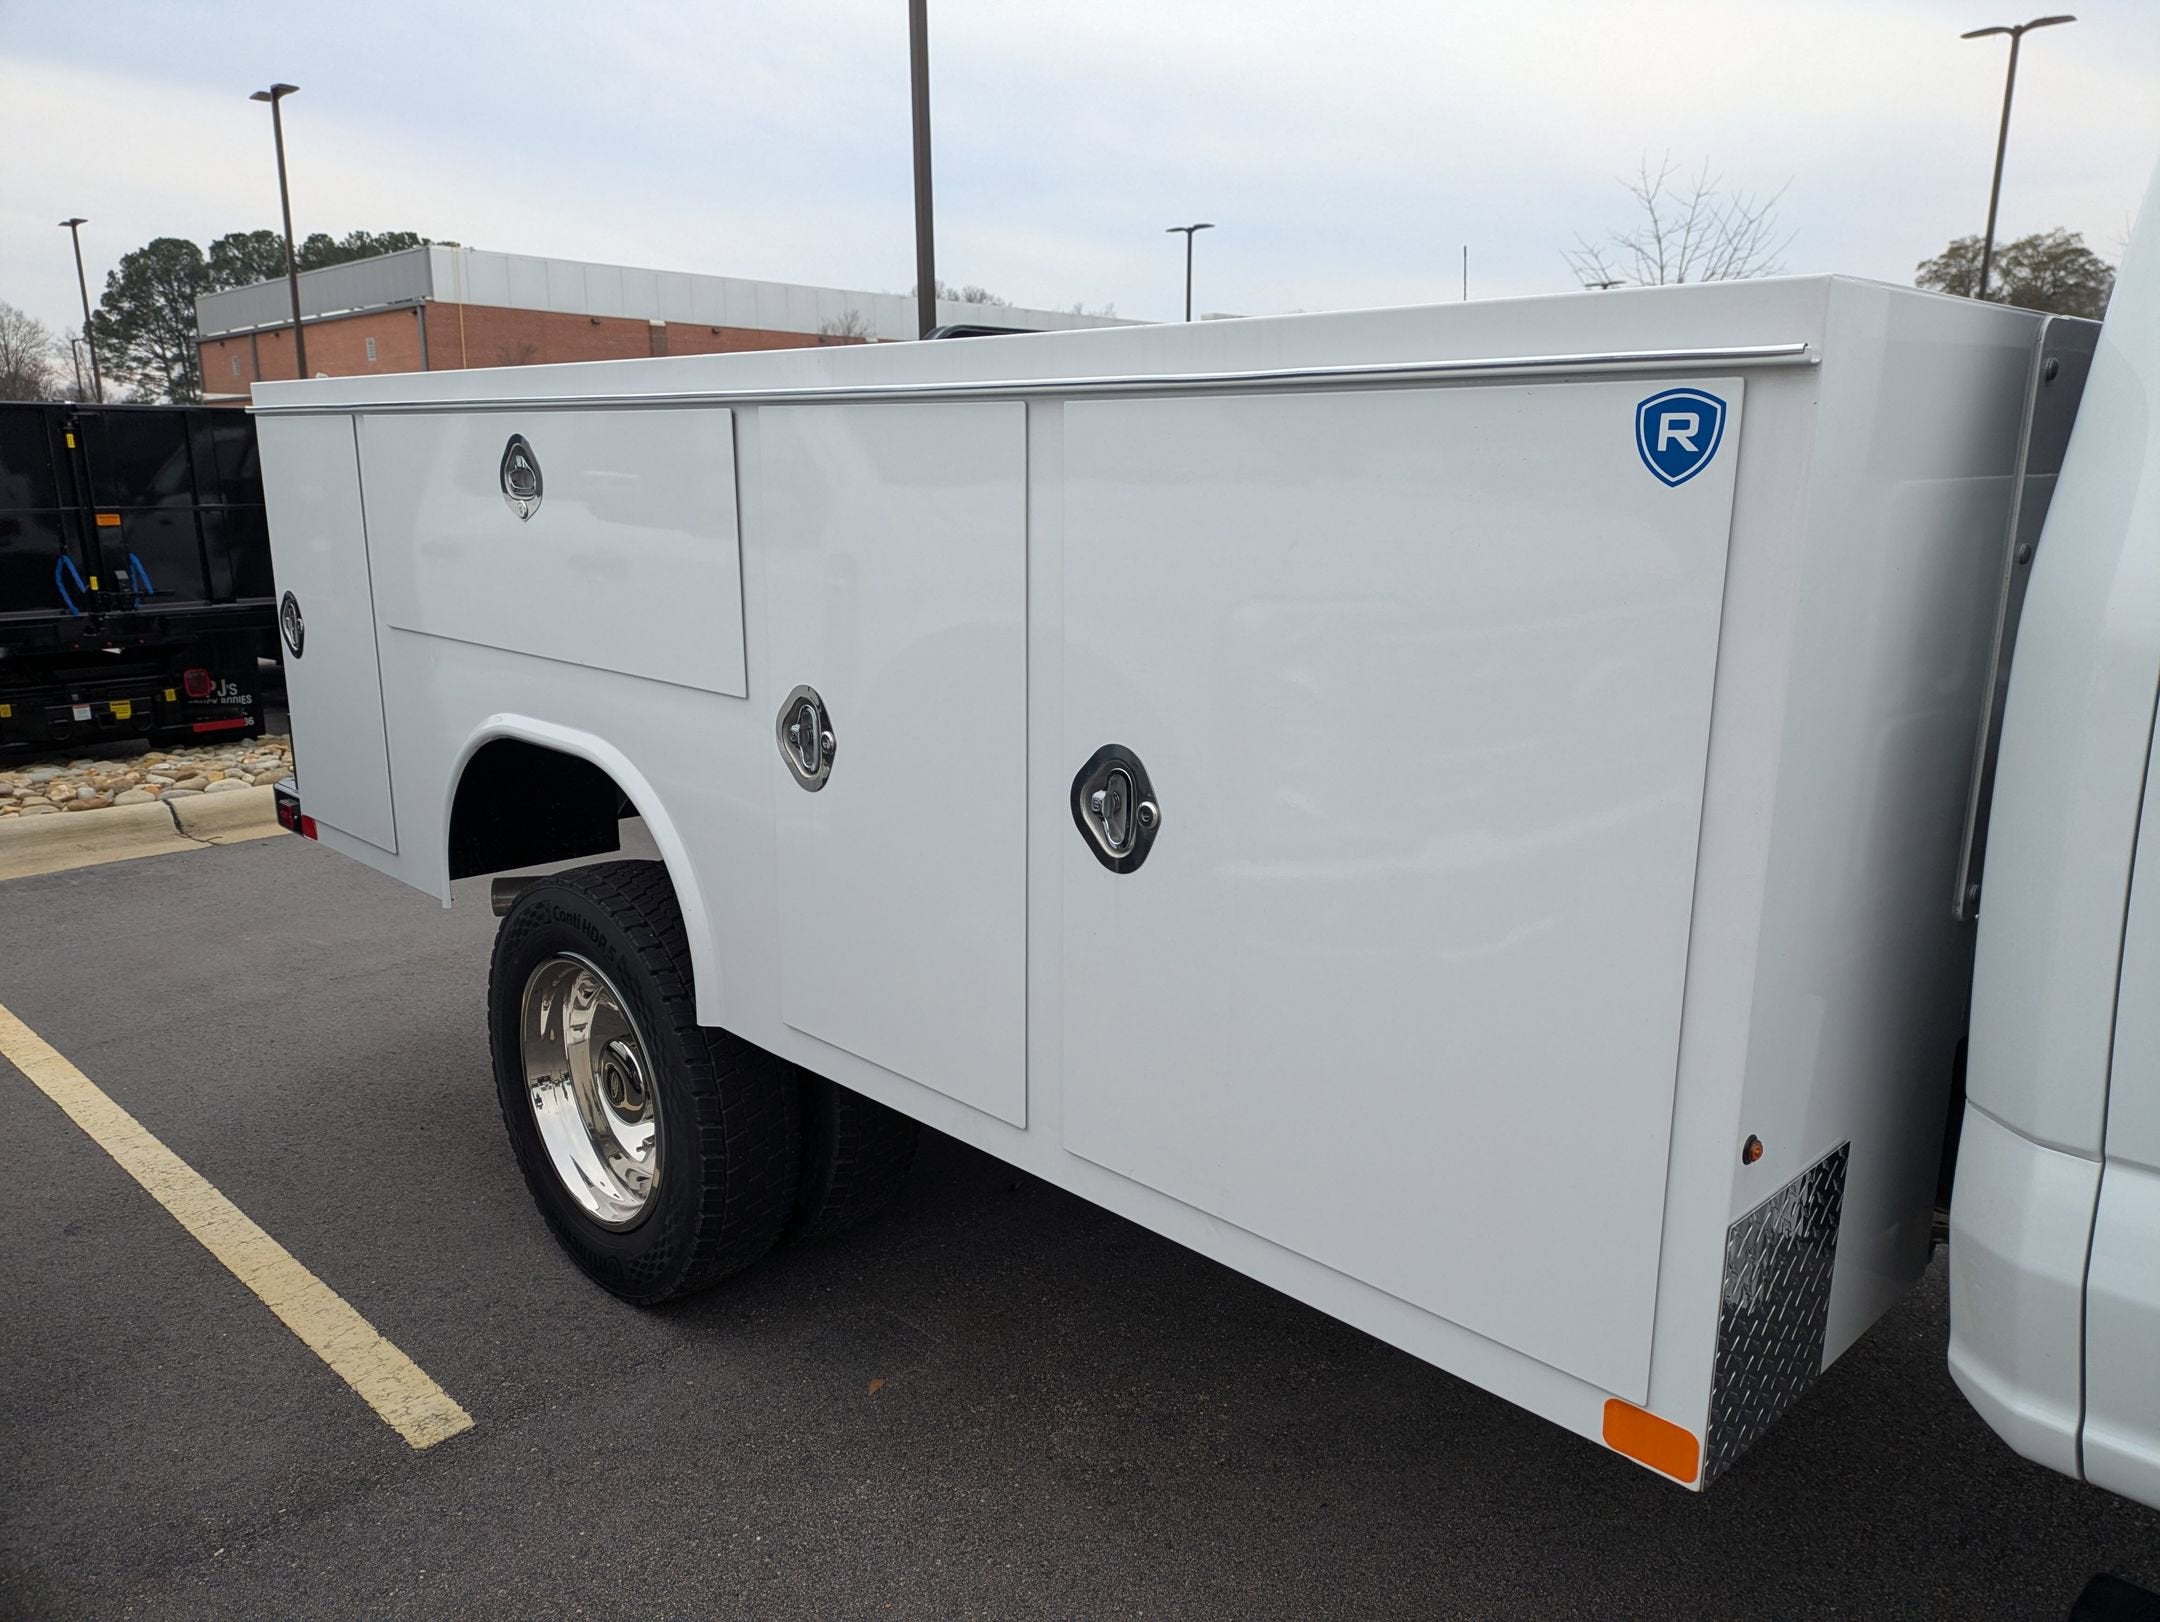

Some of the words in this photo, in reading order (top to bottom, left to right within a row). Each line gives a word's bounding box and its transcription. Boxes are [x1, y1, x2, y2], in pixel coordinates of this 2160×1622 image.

[1657, 412, 1700, 452] R
[553, 904, 581, 930] Conti
[582, 919, 608, 953] HDR
